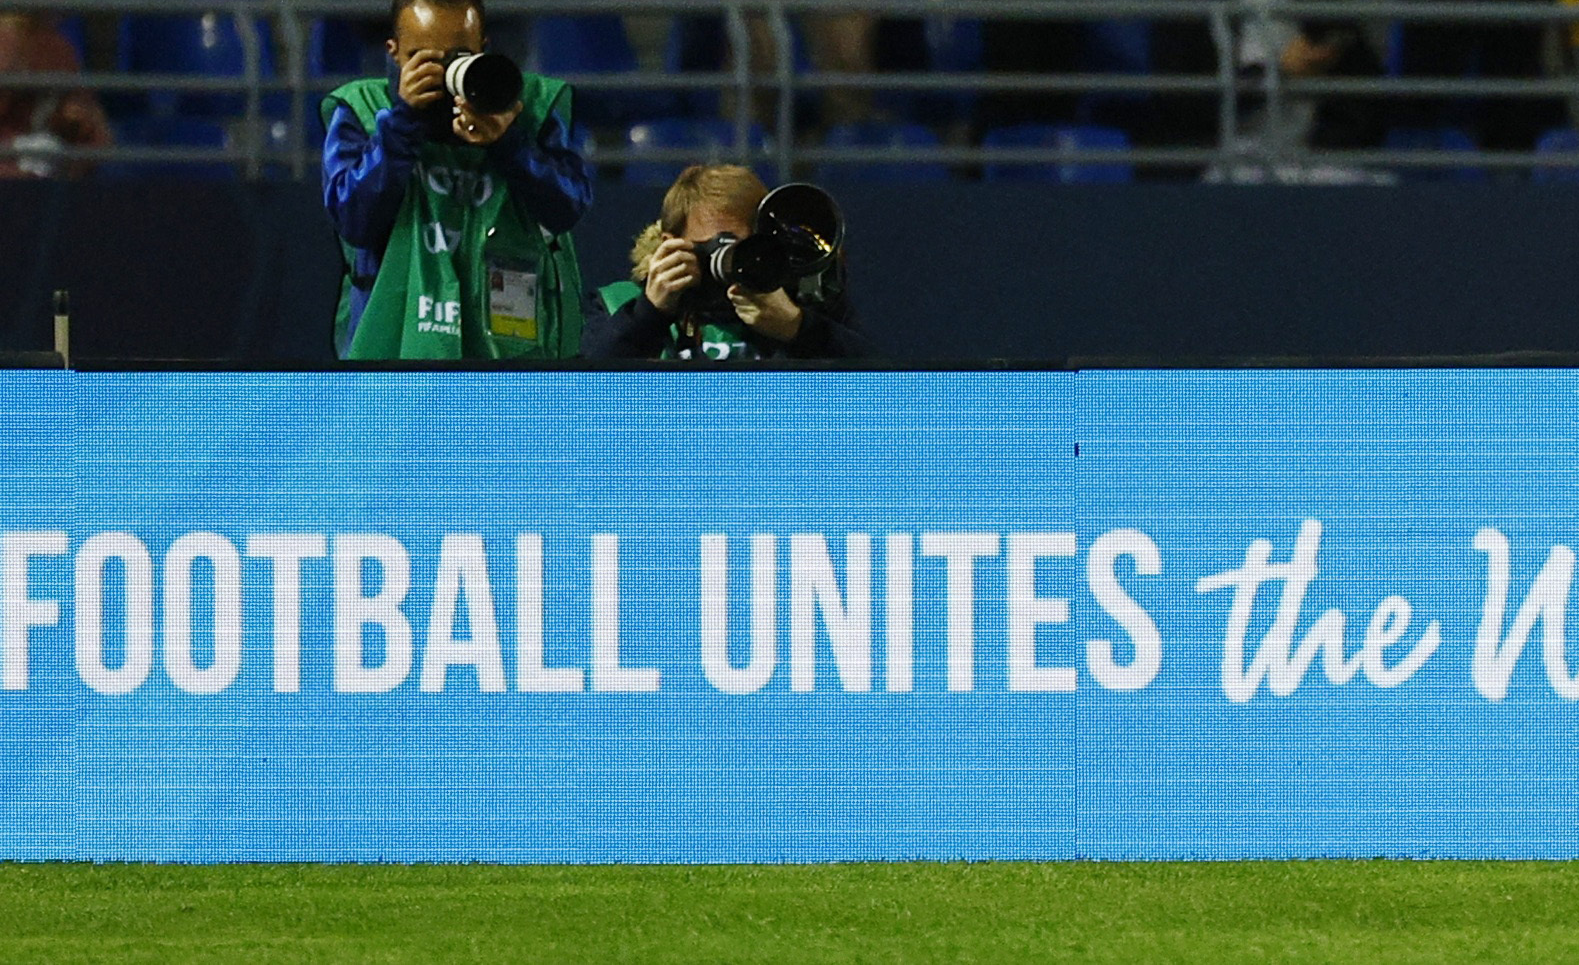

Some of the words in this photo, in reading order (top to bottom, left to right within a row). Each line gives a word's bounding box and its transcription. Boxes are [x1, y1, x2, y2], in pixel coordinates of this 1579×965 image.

[418, 295, 461, 323] FIF
[0, 531, 660, 695] FOOTBALL
[701, 528, 1162, 694] UNITES
[1197, 518, 1441, 703] the
